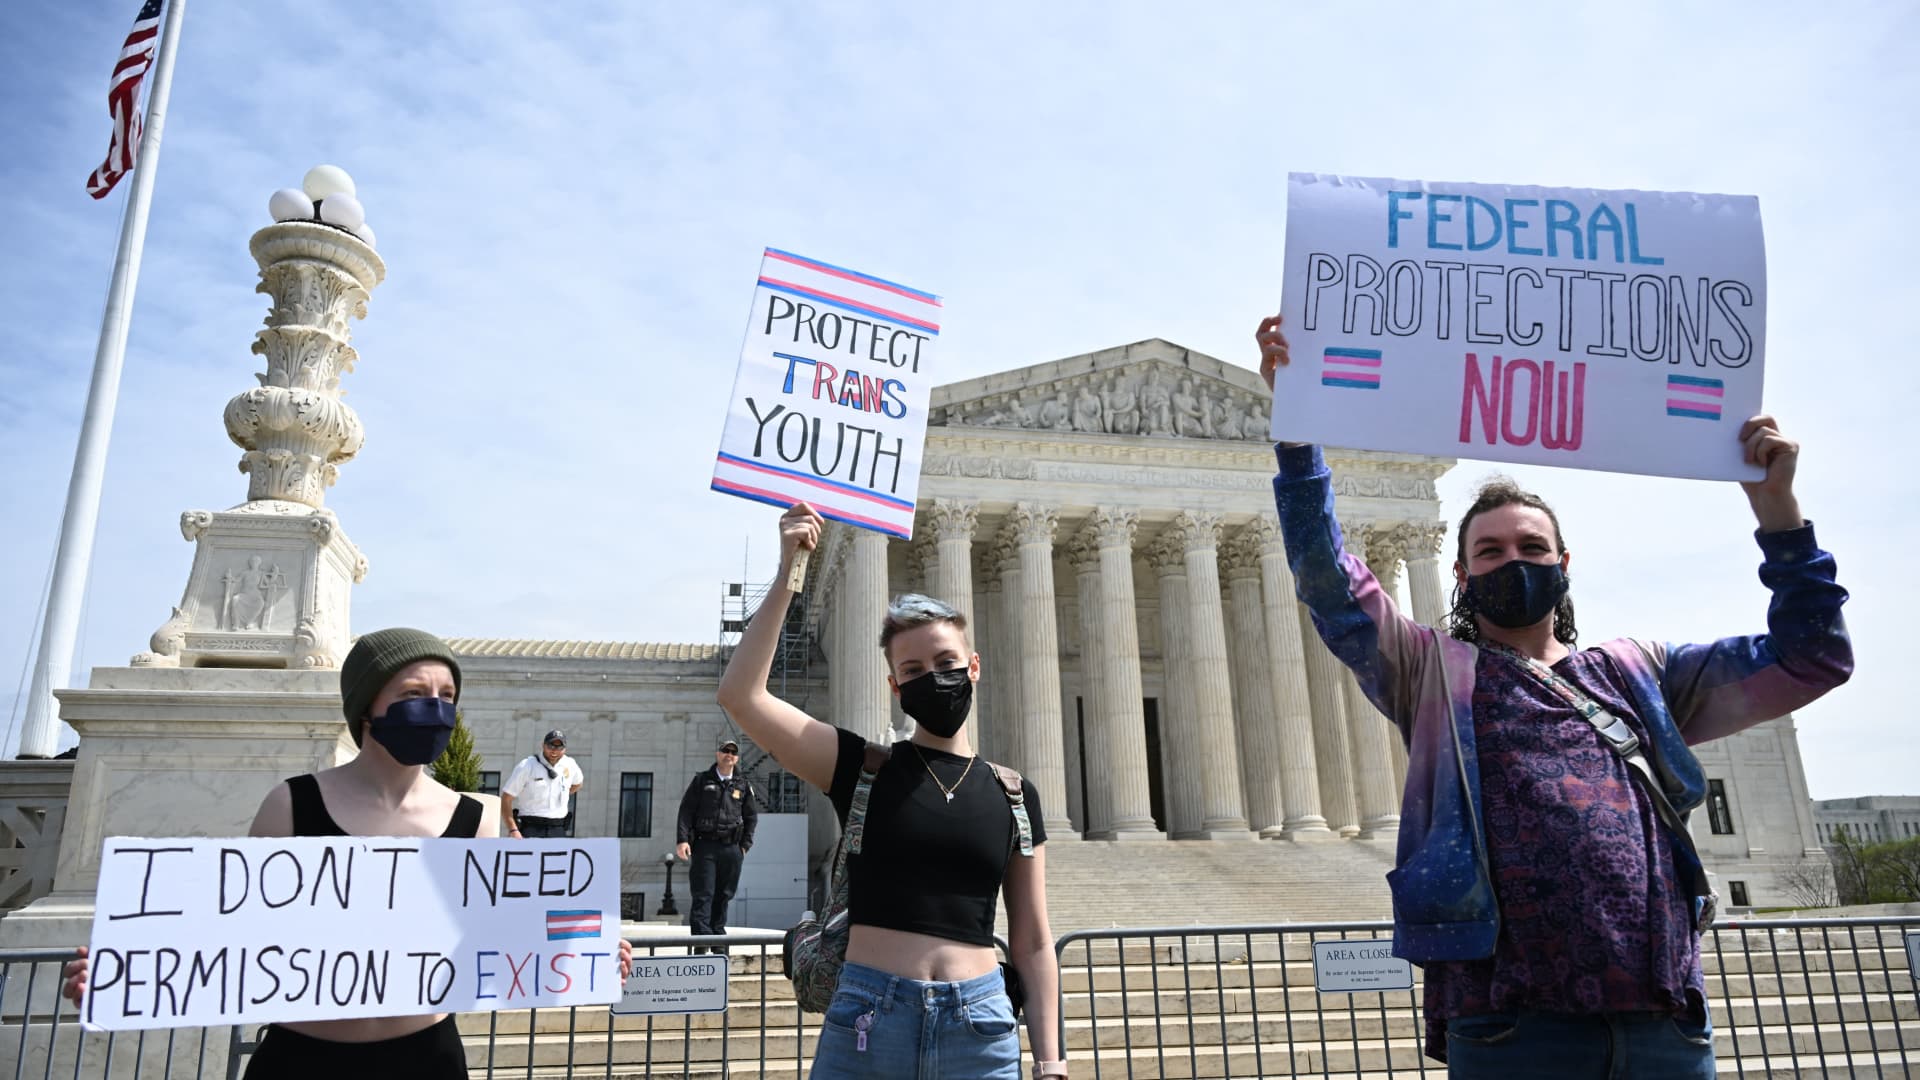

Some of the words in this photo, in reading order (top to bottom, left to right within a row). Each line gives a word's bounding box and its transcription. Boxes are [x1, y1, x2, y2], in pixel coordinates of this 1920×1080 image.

[1388, 190, 1664, 265] FEDERAL
[765, 295, 930, 374] PROTECT
[1304, 252, 1753, 368] PROTECTIONS
[773, 352, 907, 419] TRANS
[1460, 353, 1586, 451] NOW
[745, 397, 903, 494] YOUTH
[109, 847, 194, 921] I
[219, 845, 419, 914] DON'T
[463, 849, 594, 908] NEED
[87, 945, 390, 1022] PERMISSION
[407, 951, 456, 1006] TO
[476, 951, 610, 1000] EXIST
[667, 965, 715, 976] CLOSED
[1326, 950, 1355, 960] AREA
[1360, 948, 1392, 959] CLOSE
